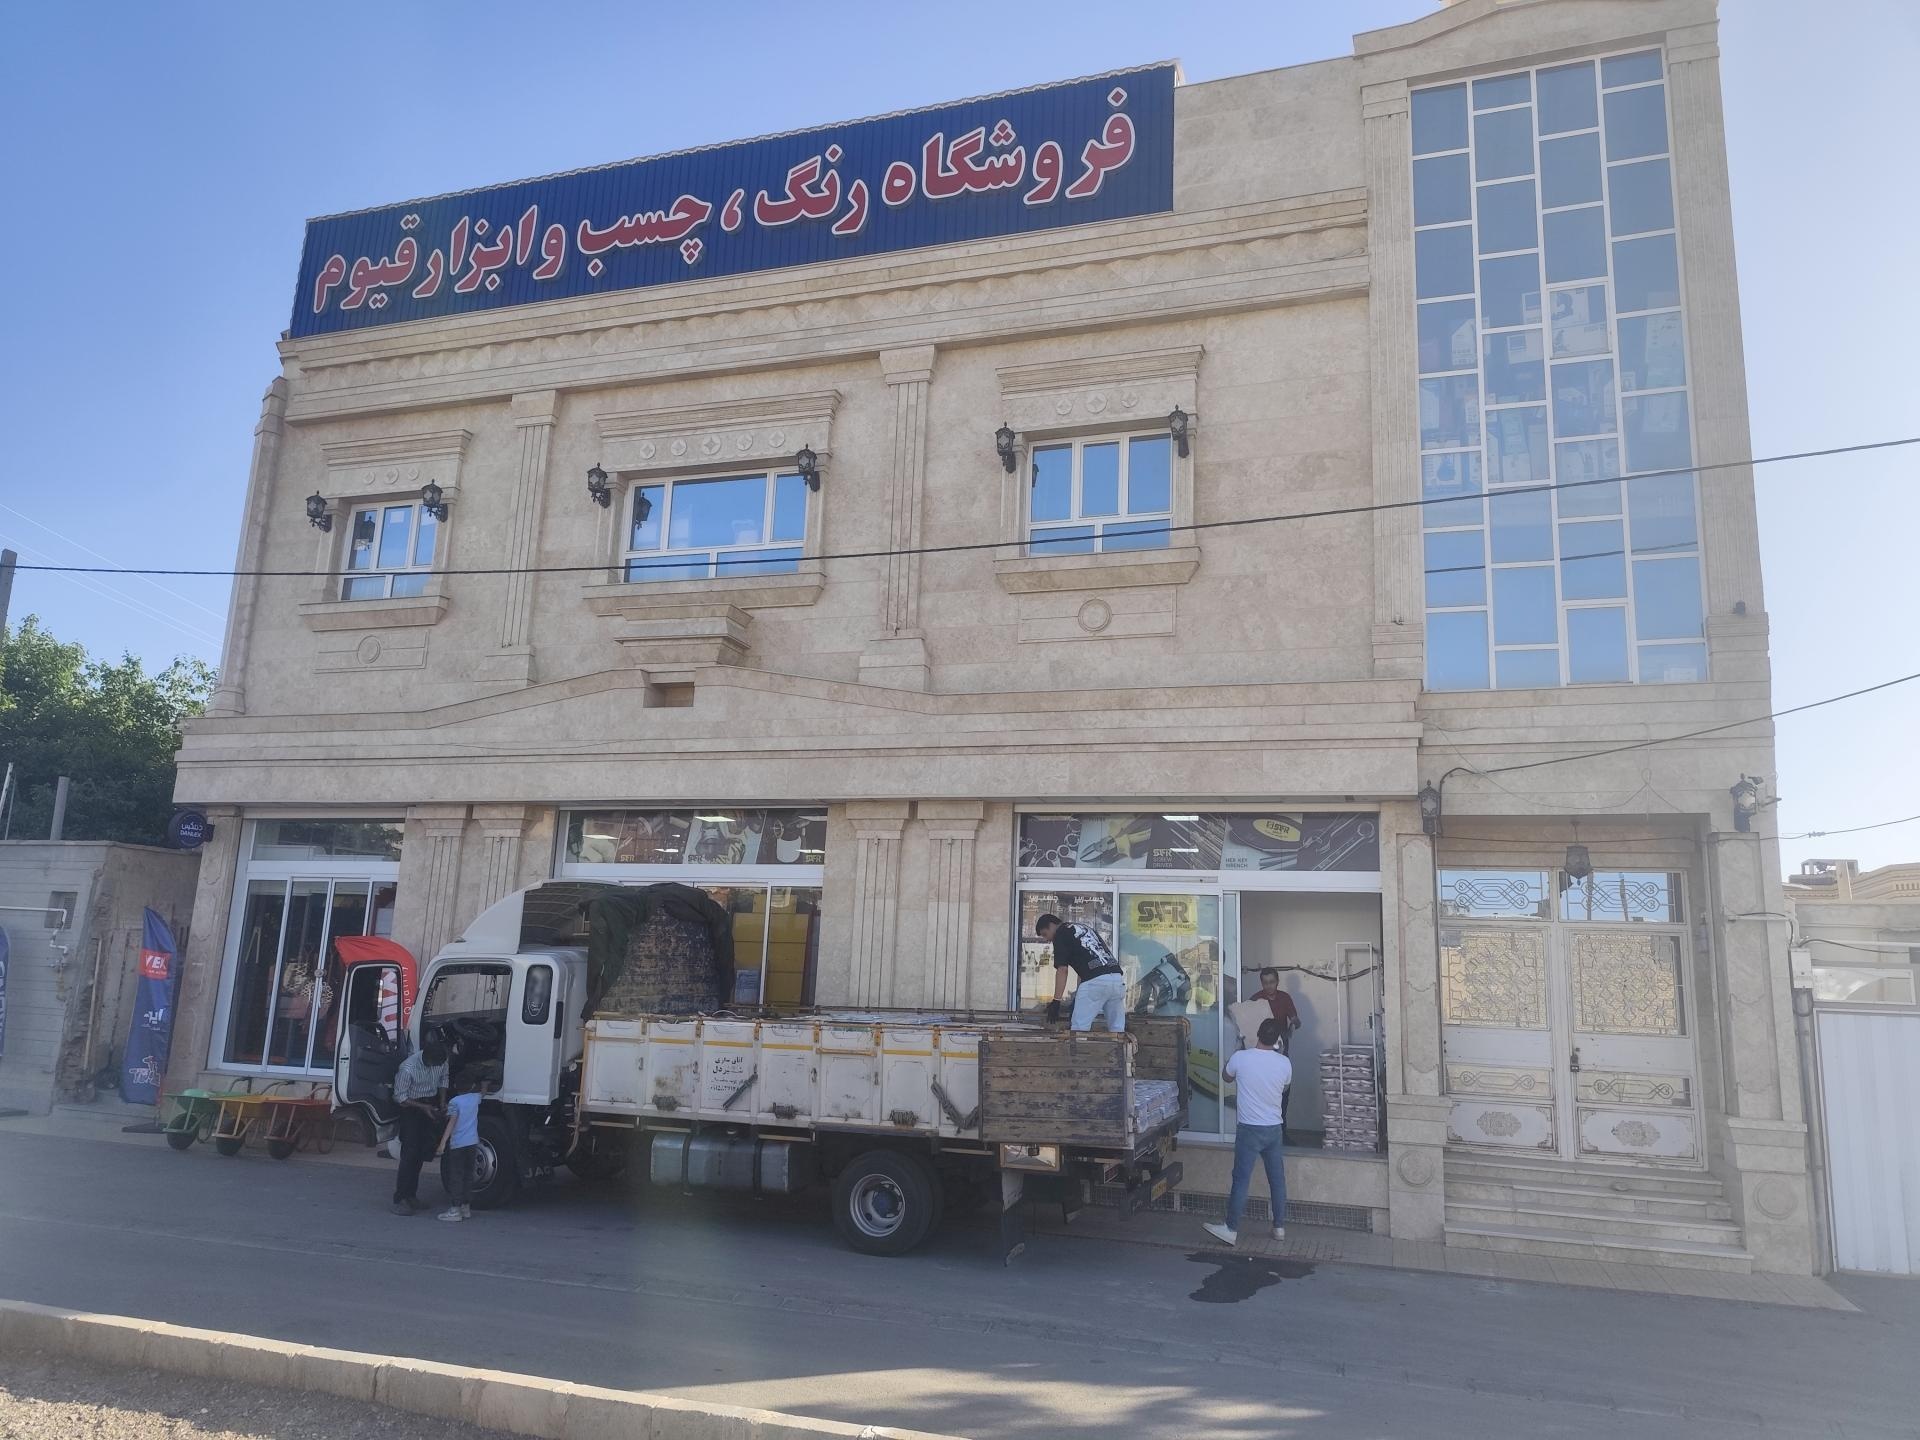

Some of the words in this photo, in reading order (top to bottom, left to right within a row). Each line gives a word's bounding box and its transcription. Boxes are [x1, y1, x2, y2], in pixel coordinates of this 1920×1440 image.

[881, 86, 1136, 205] فروشگاه
[313, 214, 418, 315] قیوم
[577, 194, 713, 277] چسب
